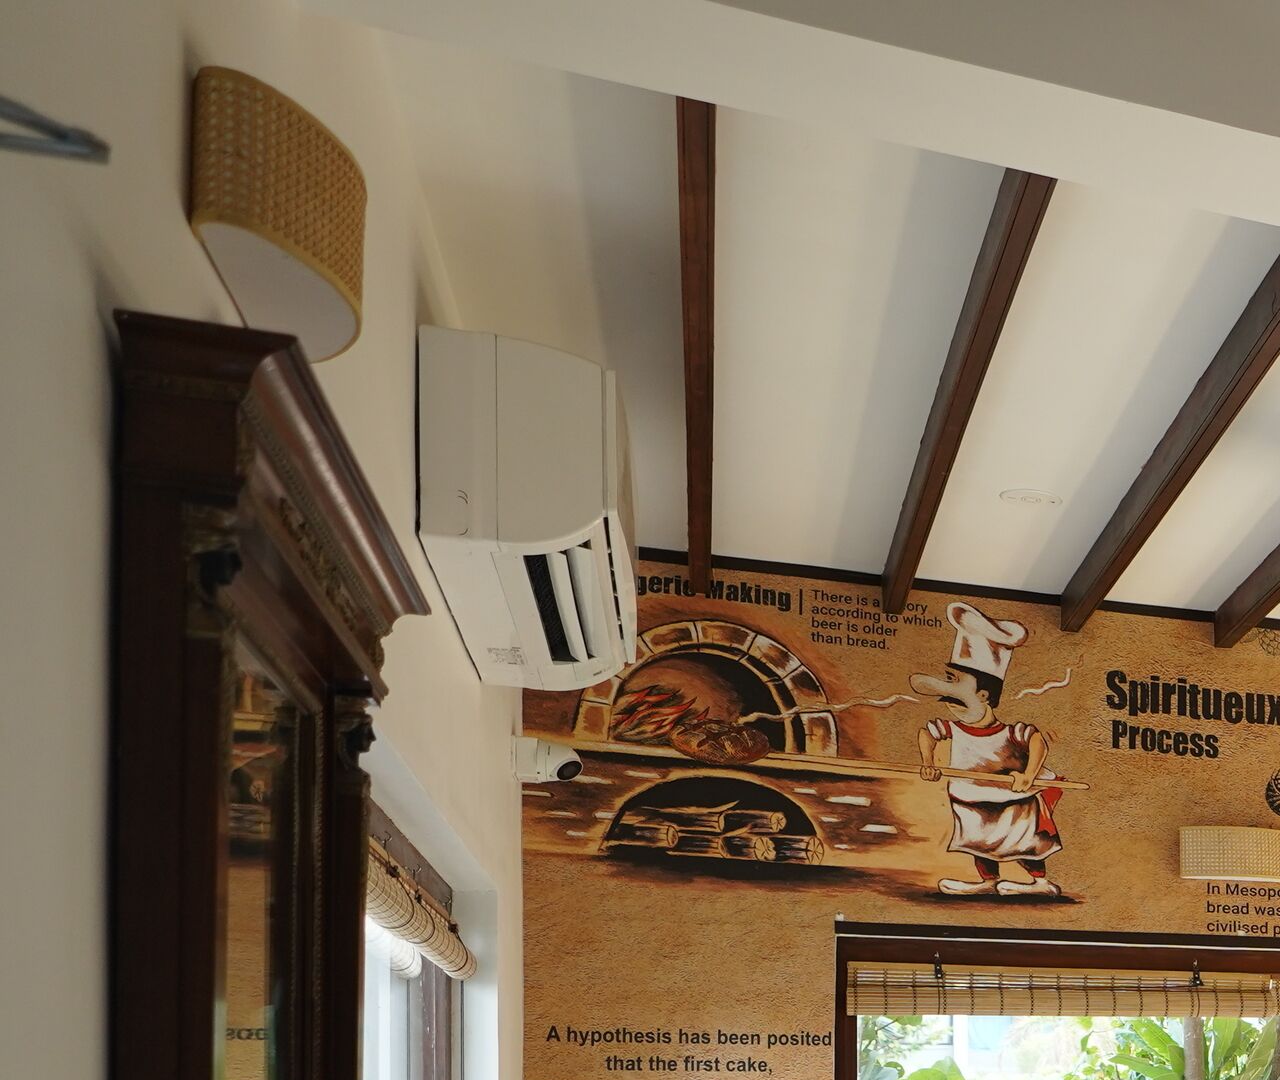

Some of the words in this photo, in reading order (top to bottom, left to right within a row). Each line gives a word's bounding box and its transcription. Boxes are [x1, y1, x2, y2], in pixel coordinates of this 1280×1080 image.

[705, 580, 791, 612] Making
[811, 589, 853, 605] There
[856, 594, 869, 606] is
[872, 599, 880, 608] a
[903, 602, 928, 615] ory
[811, 605, 881, 623] according
[885, 613, 899, 623] to
[903, 614, 942, 628] which
[811, 617, 842, 630] beer
[847, 620, 859, 633] is
[863, 625, 898, 637] older
[811, 631, 842, 646] than
[847, 635, 891, 650] bread.
[1112, 719, 1219, 758] Process
[1206, 882, 1221, 895] In
[1206, 901, 1250, 915] bread
[1206, 920, 1269, 935] civilised
[546, 1025, 561, 1042] A
[566, 1026, 672, 1046] hypothesis
[678, 1028, 711, 1045] has
[717, 1029, 761, 1045] been
[767, 1031, 832, 1049] posited
[605, 1055, 643, 1071] that
[649, 1055, 678, 1072] the
[684, 1055, 721, 1072] first
[726, 1056, 773, 1075] cake,
